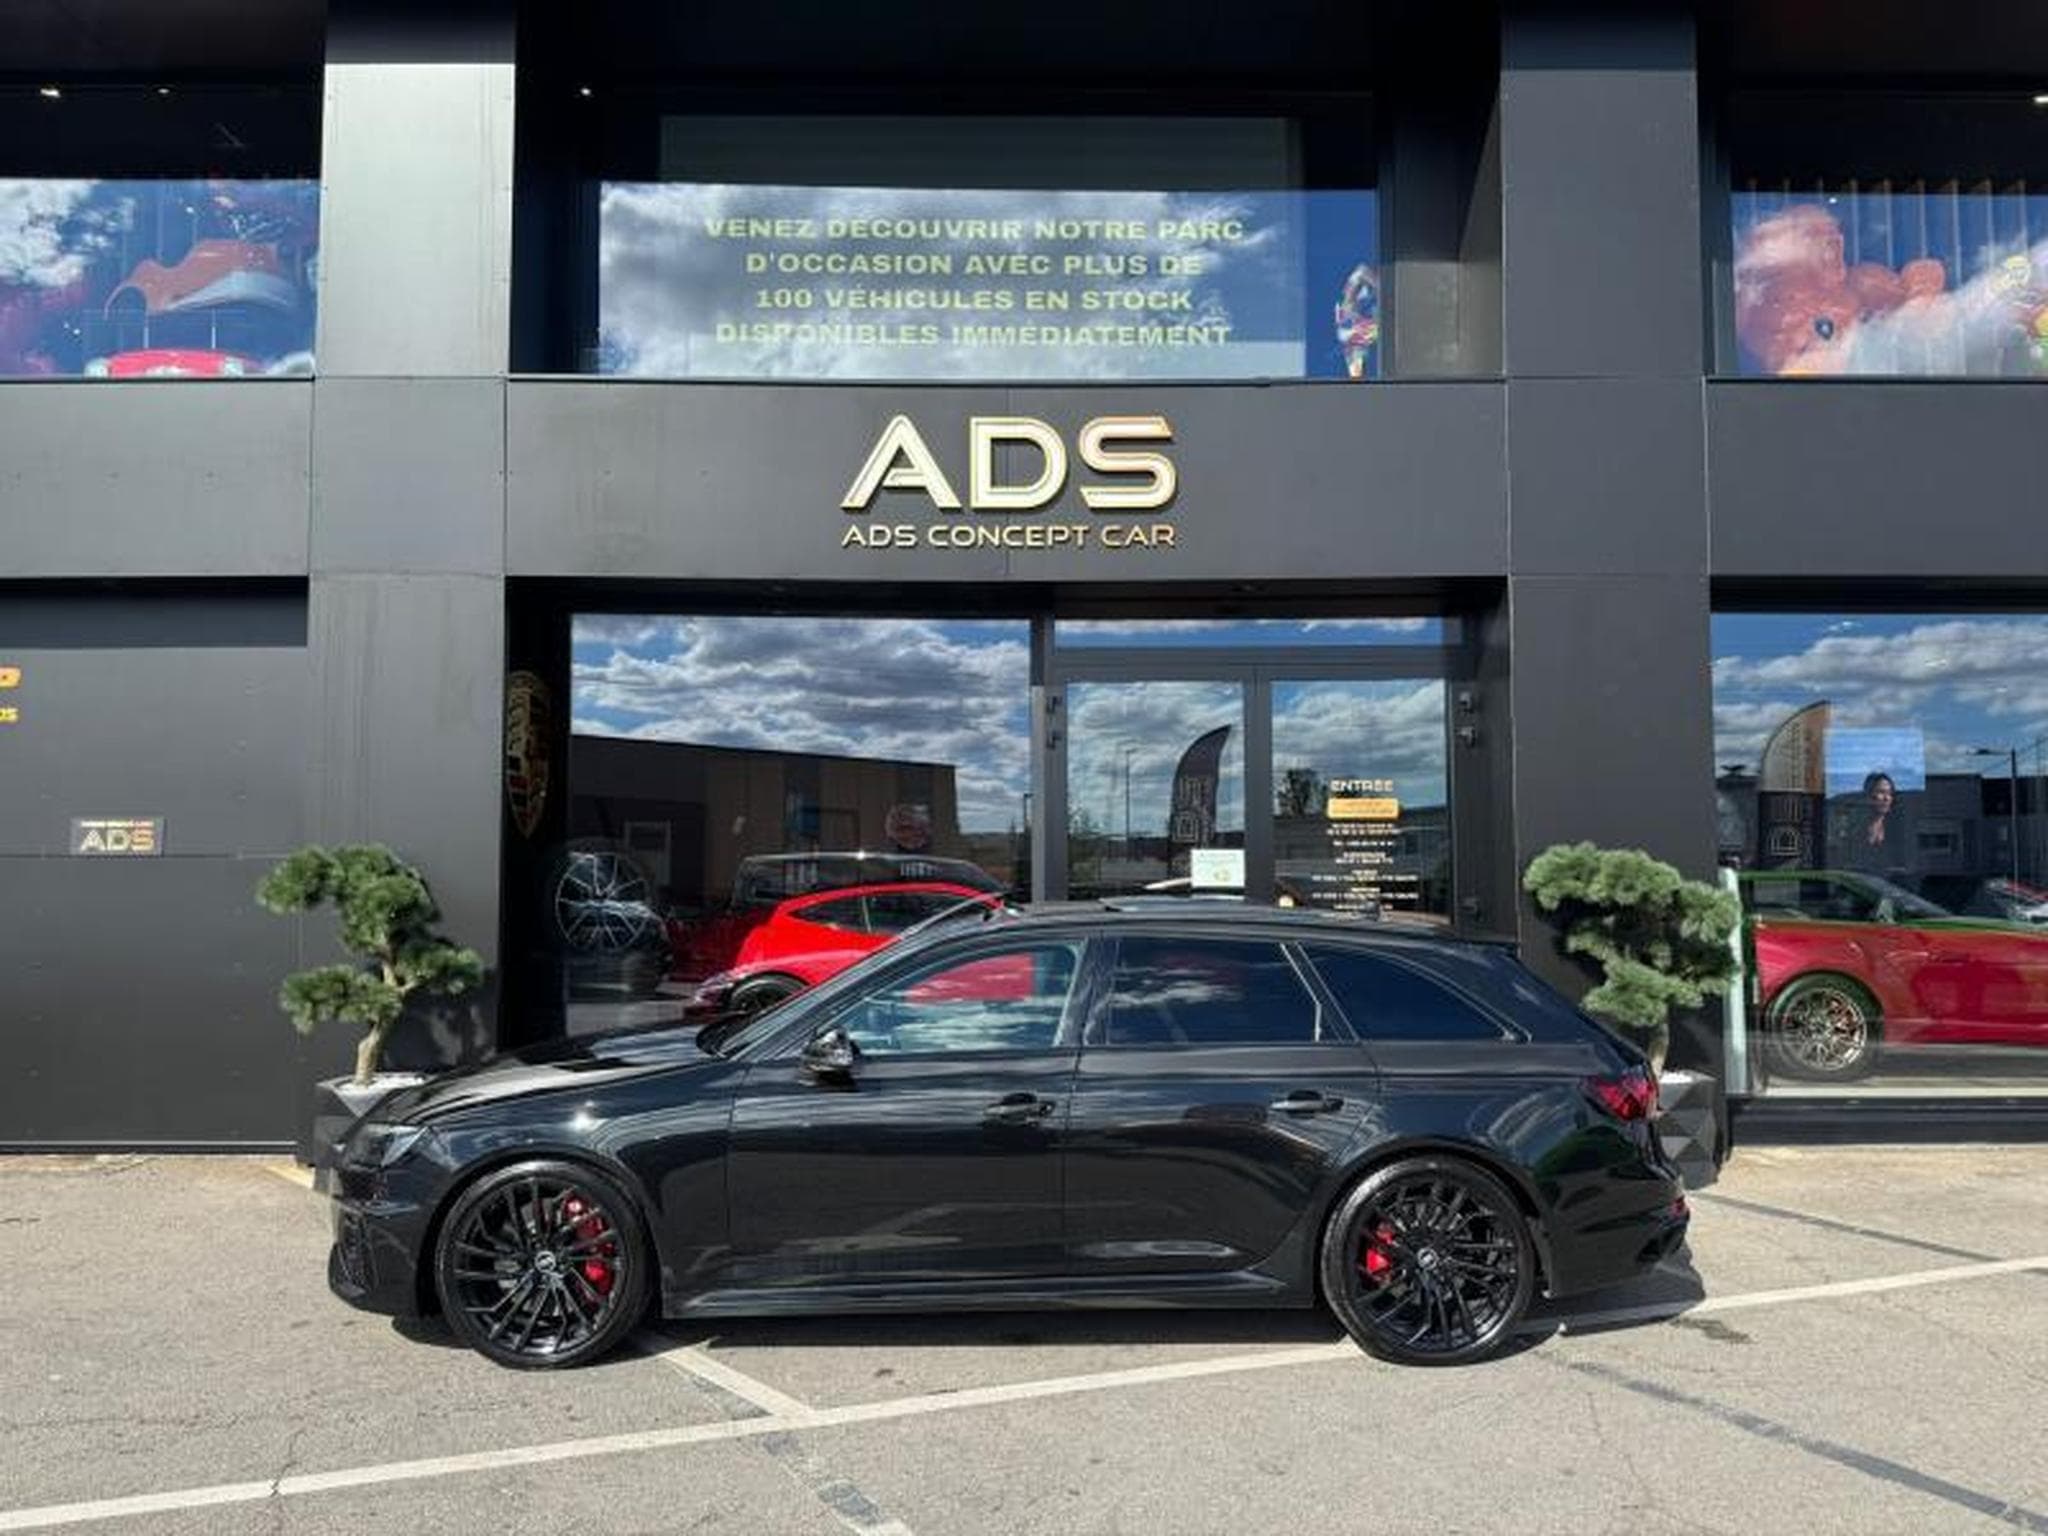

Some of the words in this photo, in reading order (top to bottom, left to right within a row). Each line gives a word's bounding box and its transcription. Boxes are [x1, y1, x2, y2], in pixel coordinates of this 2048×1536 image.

[705, 219, 817, 239] VENEZ
[1034, 220, 1147, 240] NOTRE
[1158, 220, 1244, 240] PARC
[746, 252, 953, 275] D'OCCASION
[965, 254, 1050, 275] AVEC
[1064, 254, 1148, 275] PLUS
[1160, 254, 1203, 275] DE
[756, 288, 813, 309] 100
[825, 283, 1013, 309] VÉHICULES
[1025, 290, 1069, 310] EN
[1081, 290, 1194, 310] STOCK
[716, 323, 939, 345] DISPONIBLES
[840, 414, 1178, 509] ADS
[841, 525, 918, 547] ADS
[927, 525, 1089, 548] CONCEPT
[1100, 525, 1176, 549] CAR
[80, 828, 155, 851] ADS
